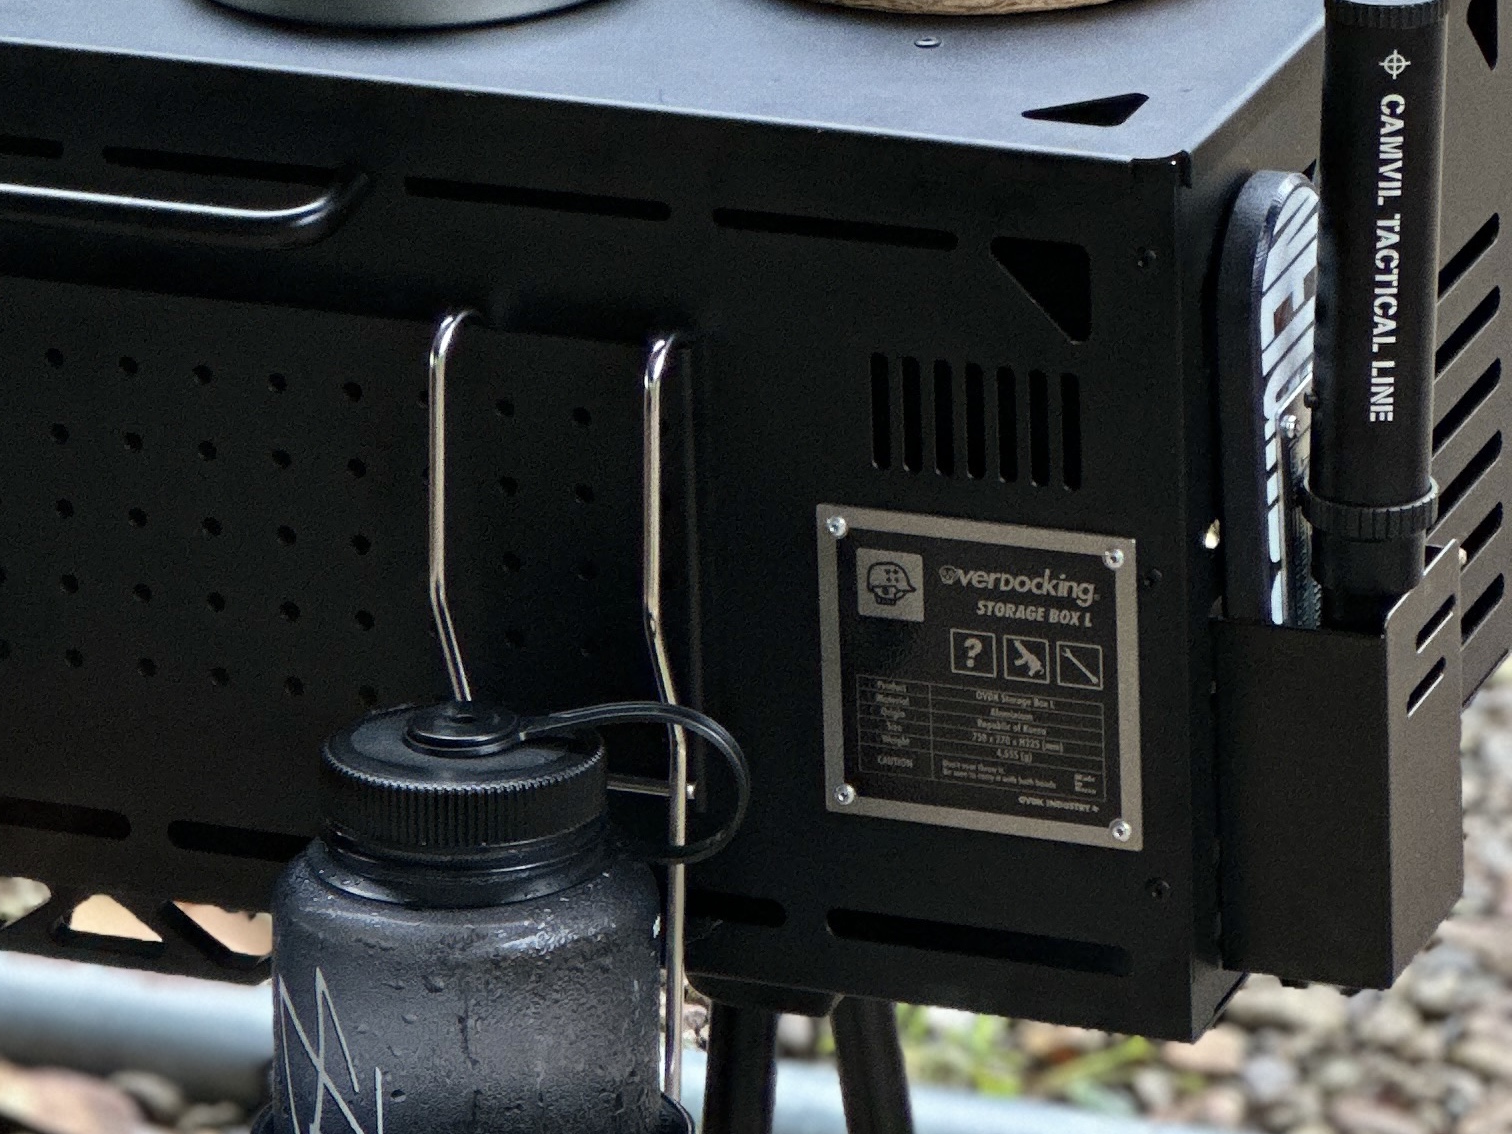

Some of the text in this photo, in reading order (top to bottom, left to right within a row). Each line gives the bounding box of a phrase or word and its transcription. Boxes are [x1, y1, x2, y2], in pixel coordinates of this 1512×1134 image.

[1369, 93, 1406, 423] CAMVIL TACTICAL LINE
[976, 600, 1093, 628] STORAGE BOX L
